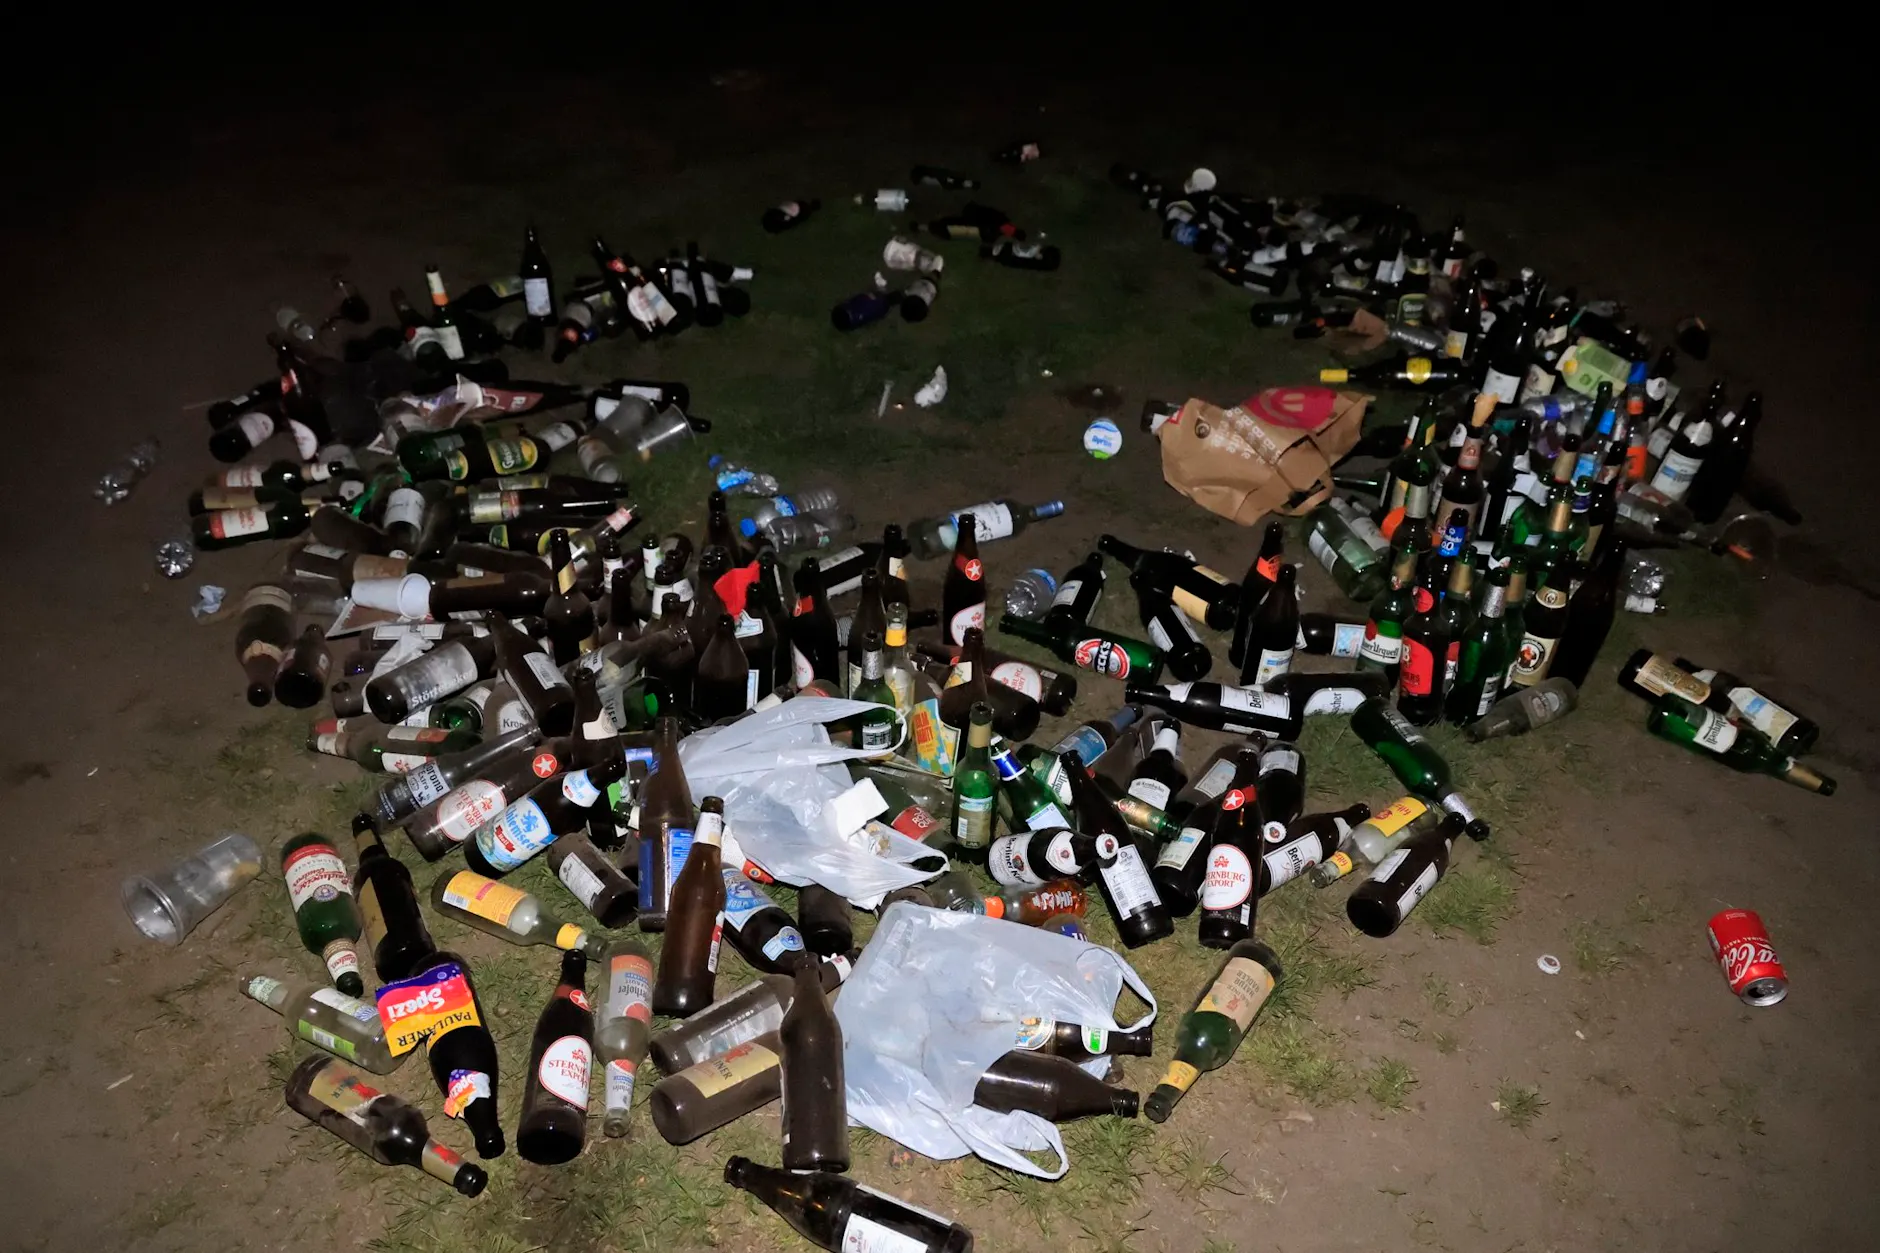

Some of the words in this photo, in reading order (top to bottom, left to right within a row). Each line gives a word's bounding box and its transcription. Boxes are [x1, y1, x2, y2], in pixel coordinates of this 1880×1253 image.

[1097, 641, 1112, 674] ECK'S
[458, 789, 486, 826] STERNBUR
[1206, 871, 1246, 883] ERNBURG
[387, 987, 445, 1022] Spezi
[397, 1011, 472, 1047] PAULANER
